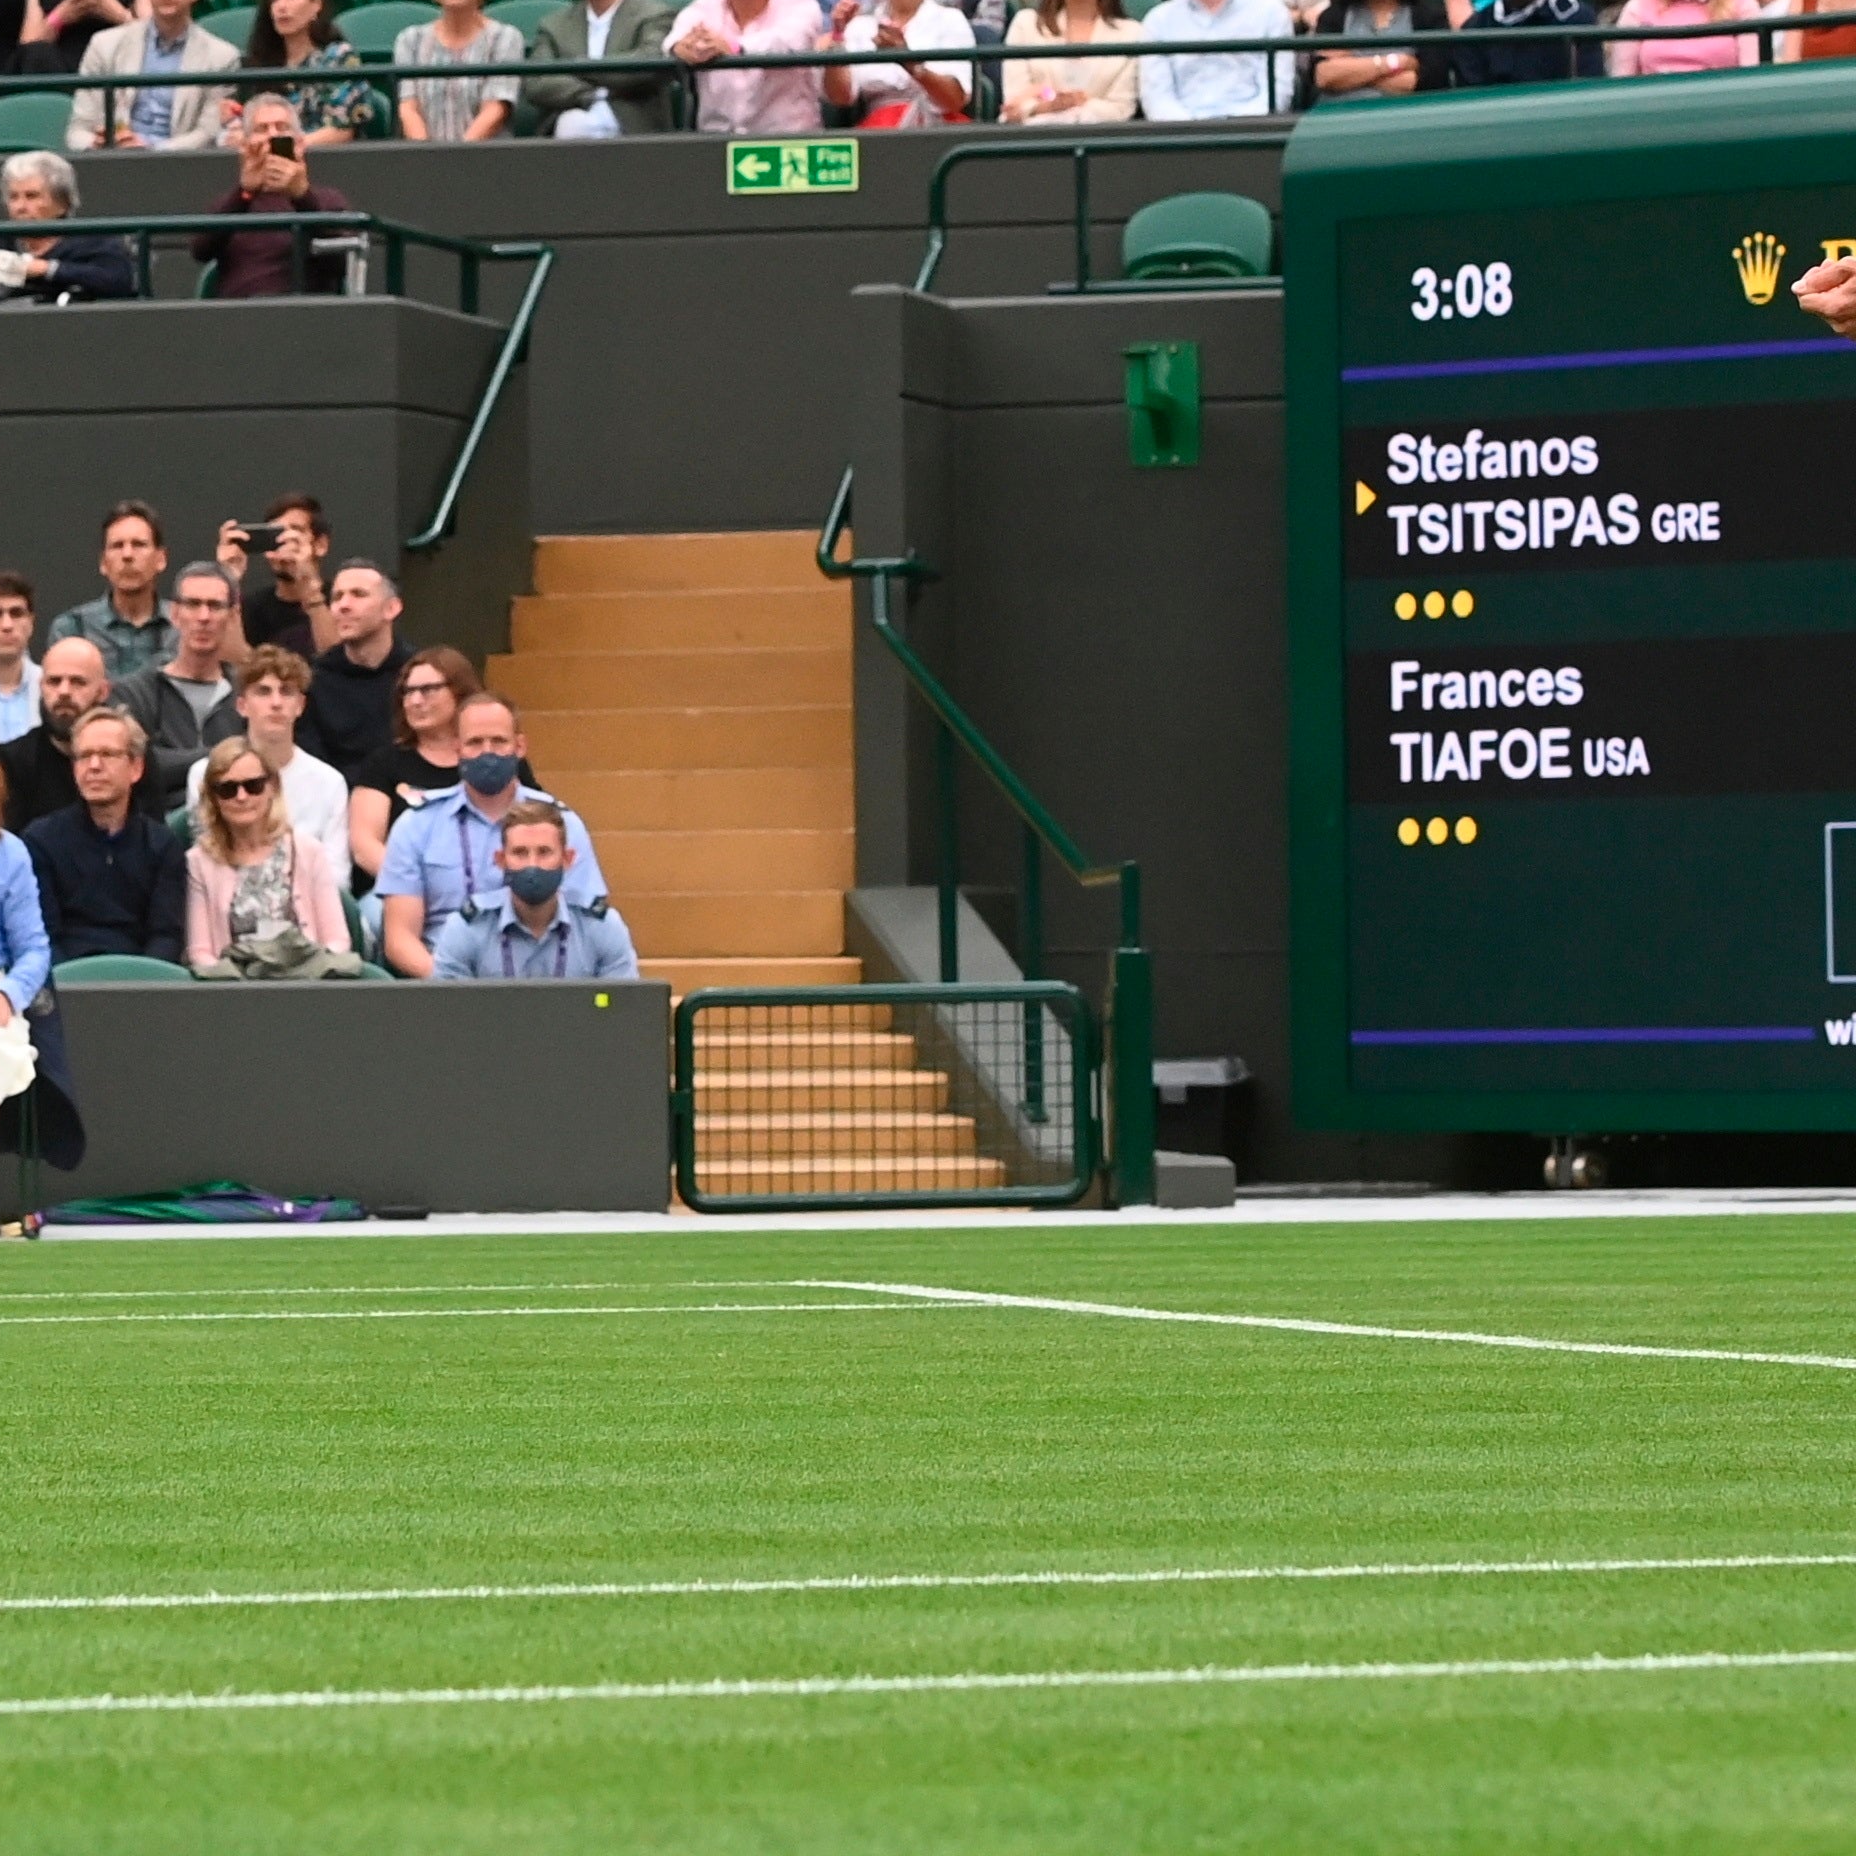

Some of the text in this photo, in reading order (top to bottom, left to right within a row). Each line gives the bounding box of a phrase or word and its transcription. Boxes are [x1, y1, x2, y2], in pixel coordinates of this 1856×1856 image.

[1411, 261, 1512, 321] 3:08
[1387, 429, 1599, 484] Stefanos
[1387, 493, 1721, 555] TSITSIPAS GRE
[1390, 661, 1584, 711] Frances
[1390, 727, 1650, 783] TIAFOE USA
